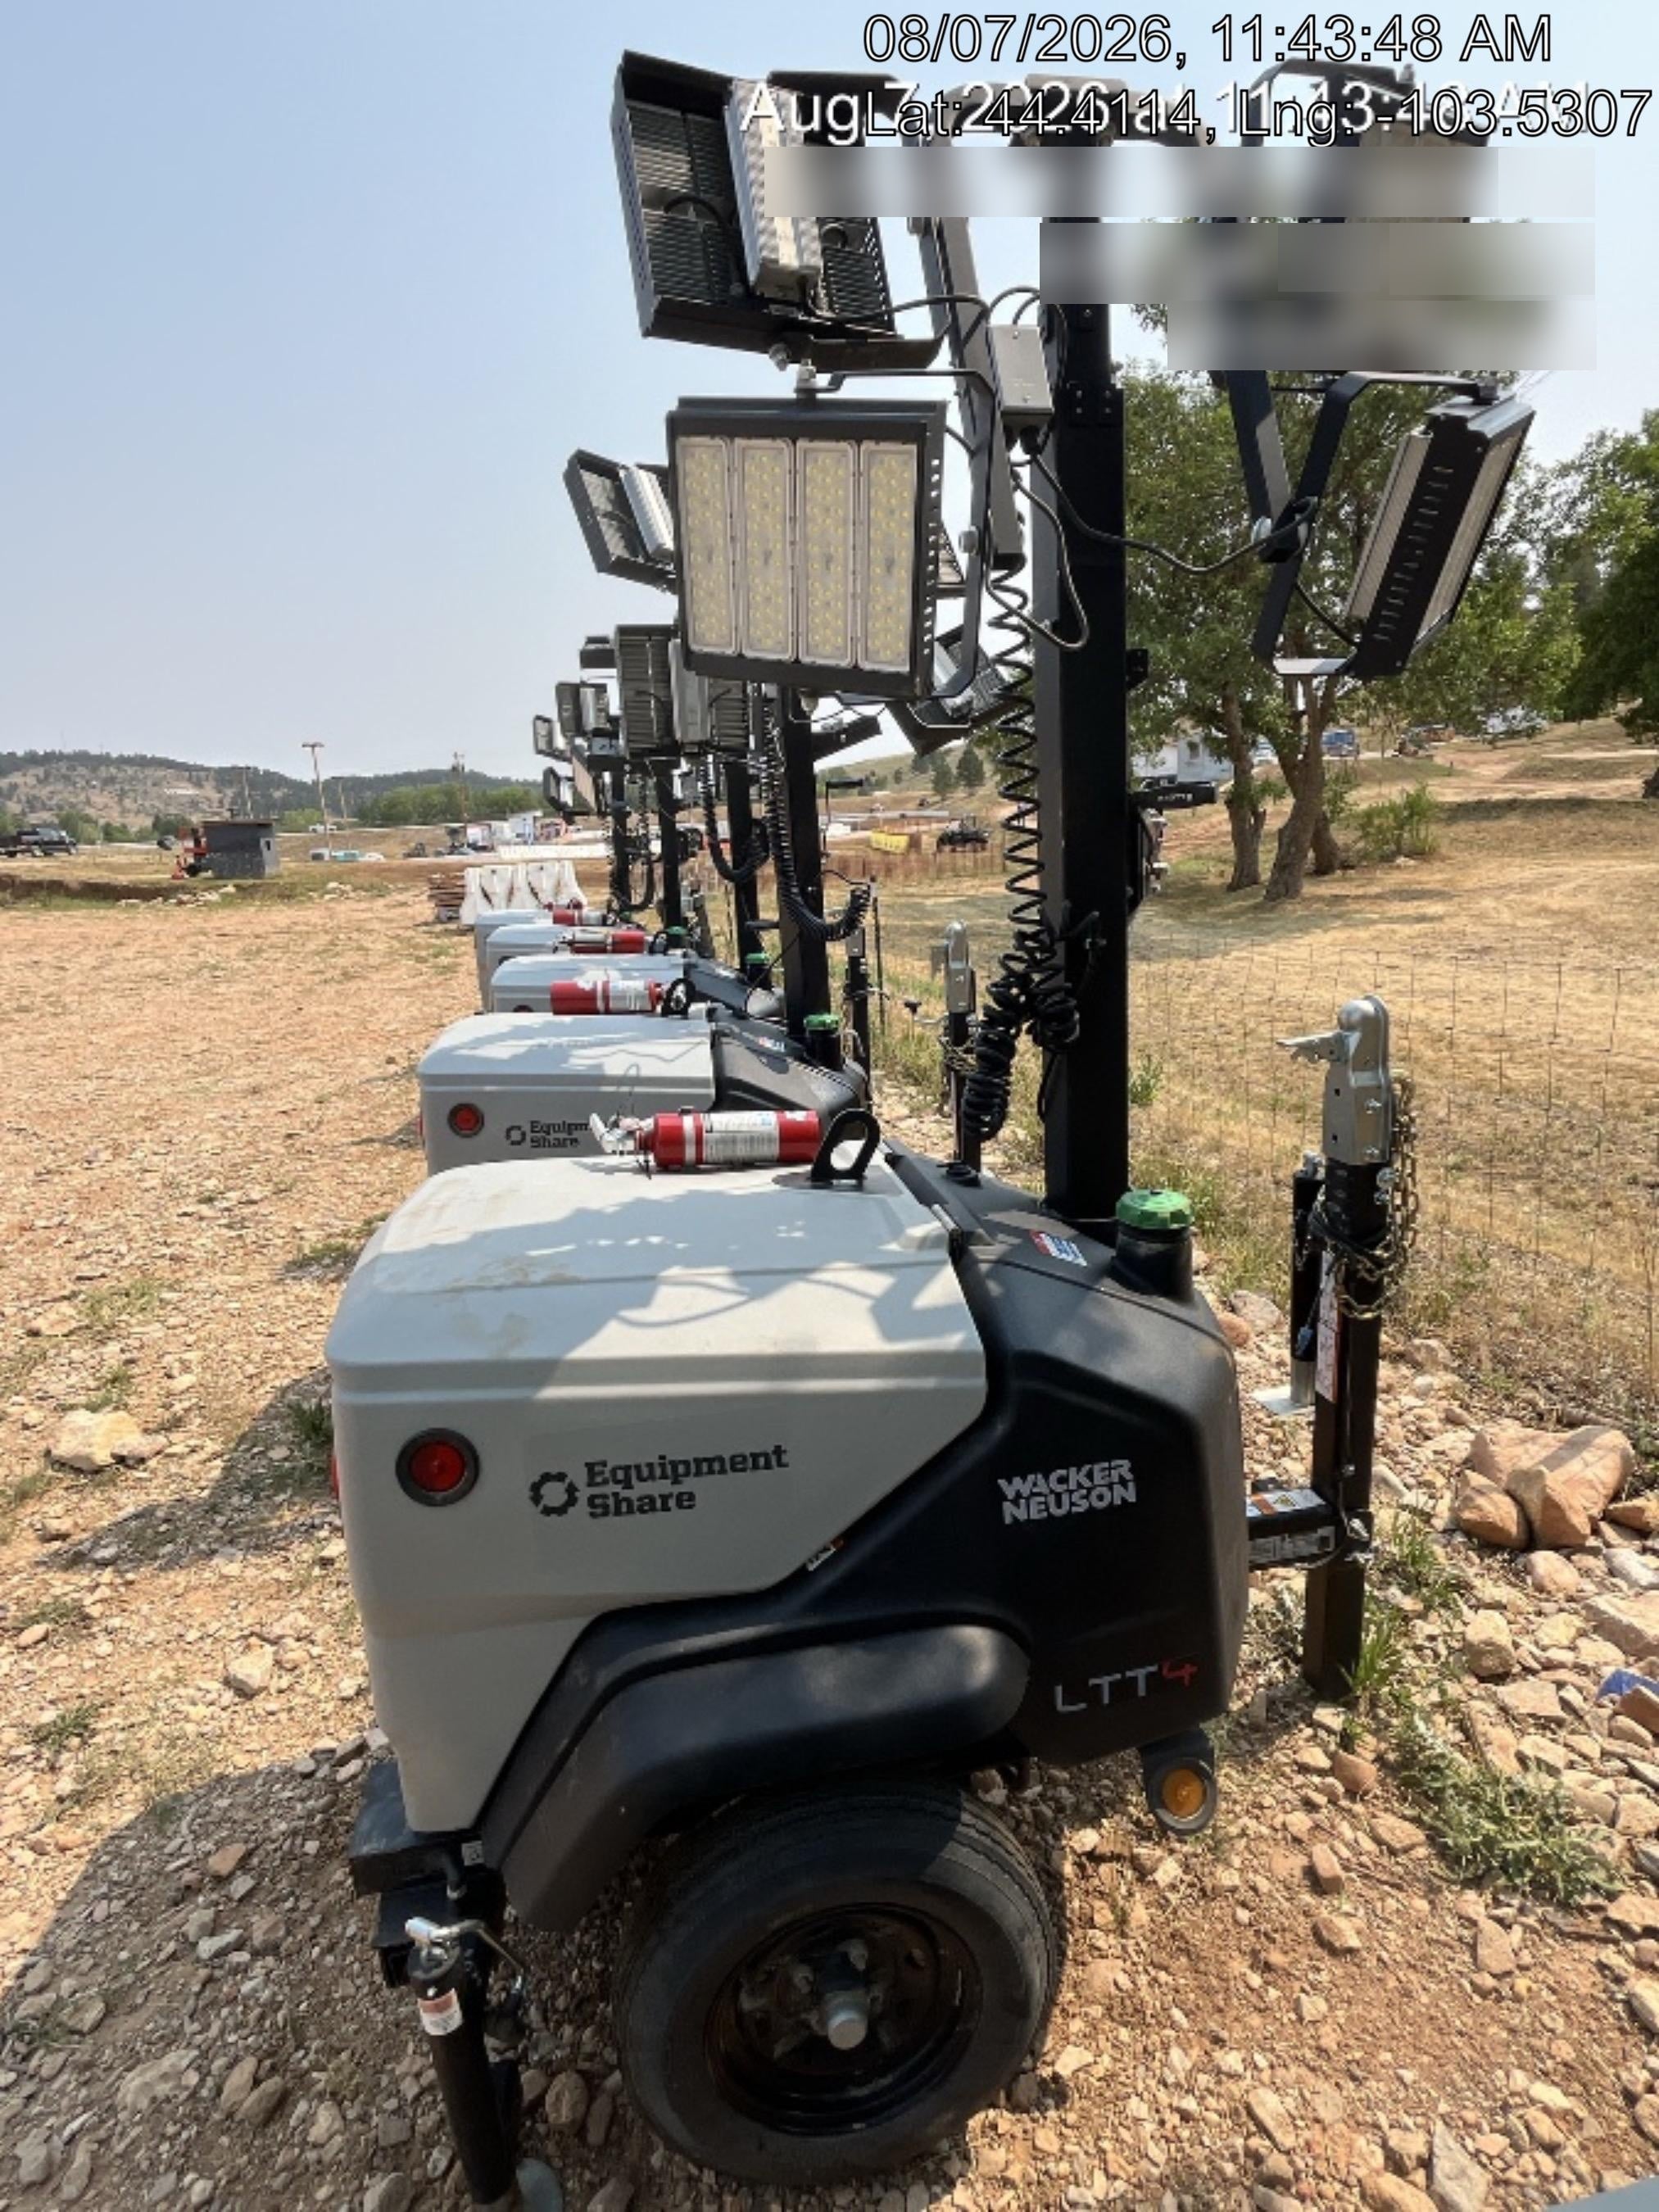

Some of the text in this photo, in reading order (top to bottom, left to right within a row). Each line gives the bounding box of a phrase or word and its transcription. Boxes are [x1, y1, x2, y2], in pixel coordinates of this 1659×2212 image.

[530, 1120, 590, 1135] Equipm
[530, 1135, 579, 1148] Share
[584, 1444, 789, 1490] Equipment
[997, 1459, 1134, 1500] WACKER
[587, 1490, 696, 1519] Share
[1002, 1481, 1137, 1525] NEUSON
[1054, 1660, 1199, 1712] LTT4
